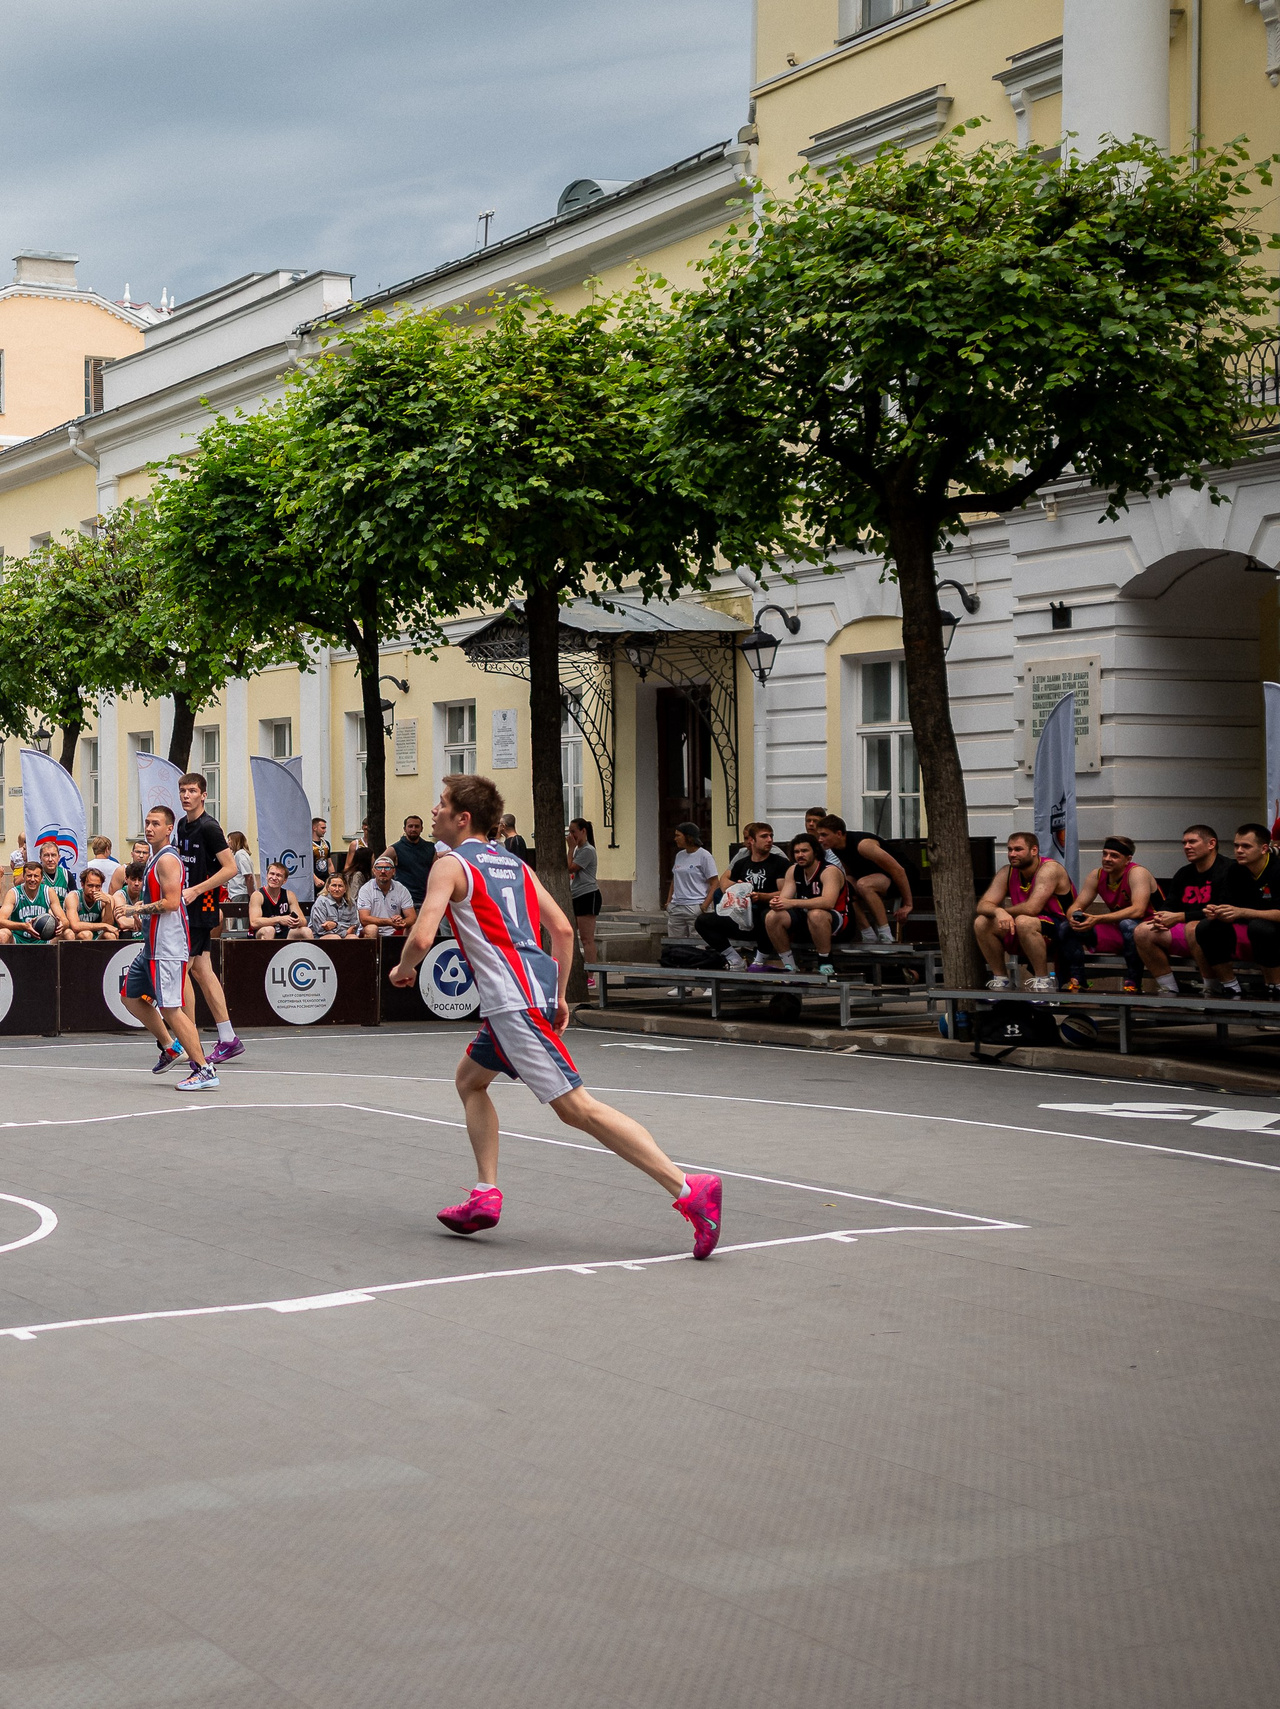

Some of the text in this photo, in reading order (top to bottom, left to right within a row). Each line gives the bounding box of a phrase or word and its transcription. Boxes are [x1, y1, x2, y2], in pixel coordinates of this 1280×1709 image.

[501, 886, 519, 929] 1
[271, 957, 330, 991] ЦСТ
[433, 1003, 472, 1011] РОСАТОМ
